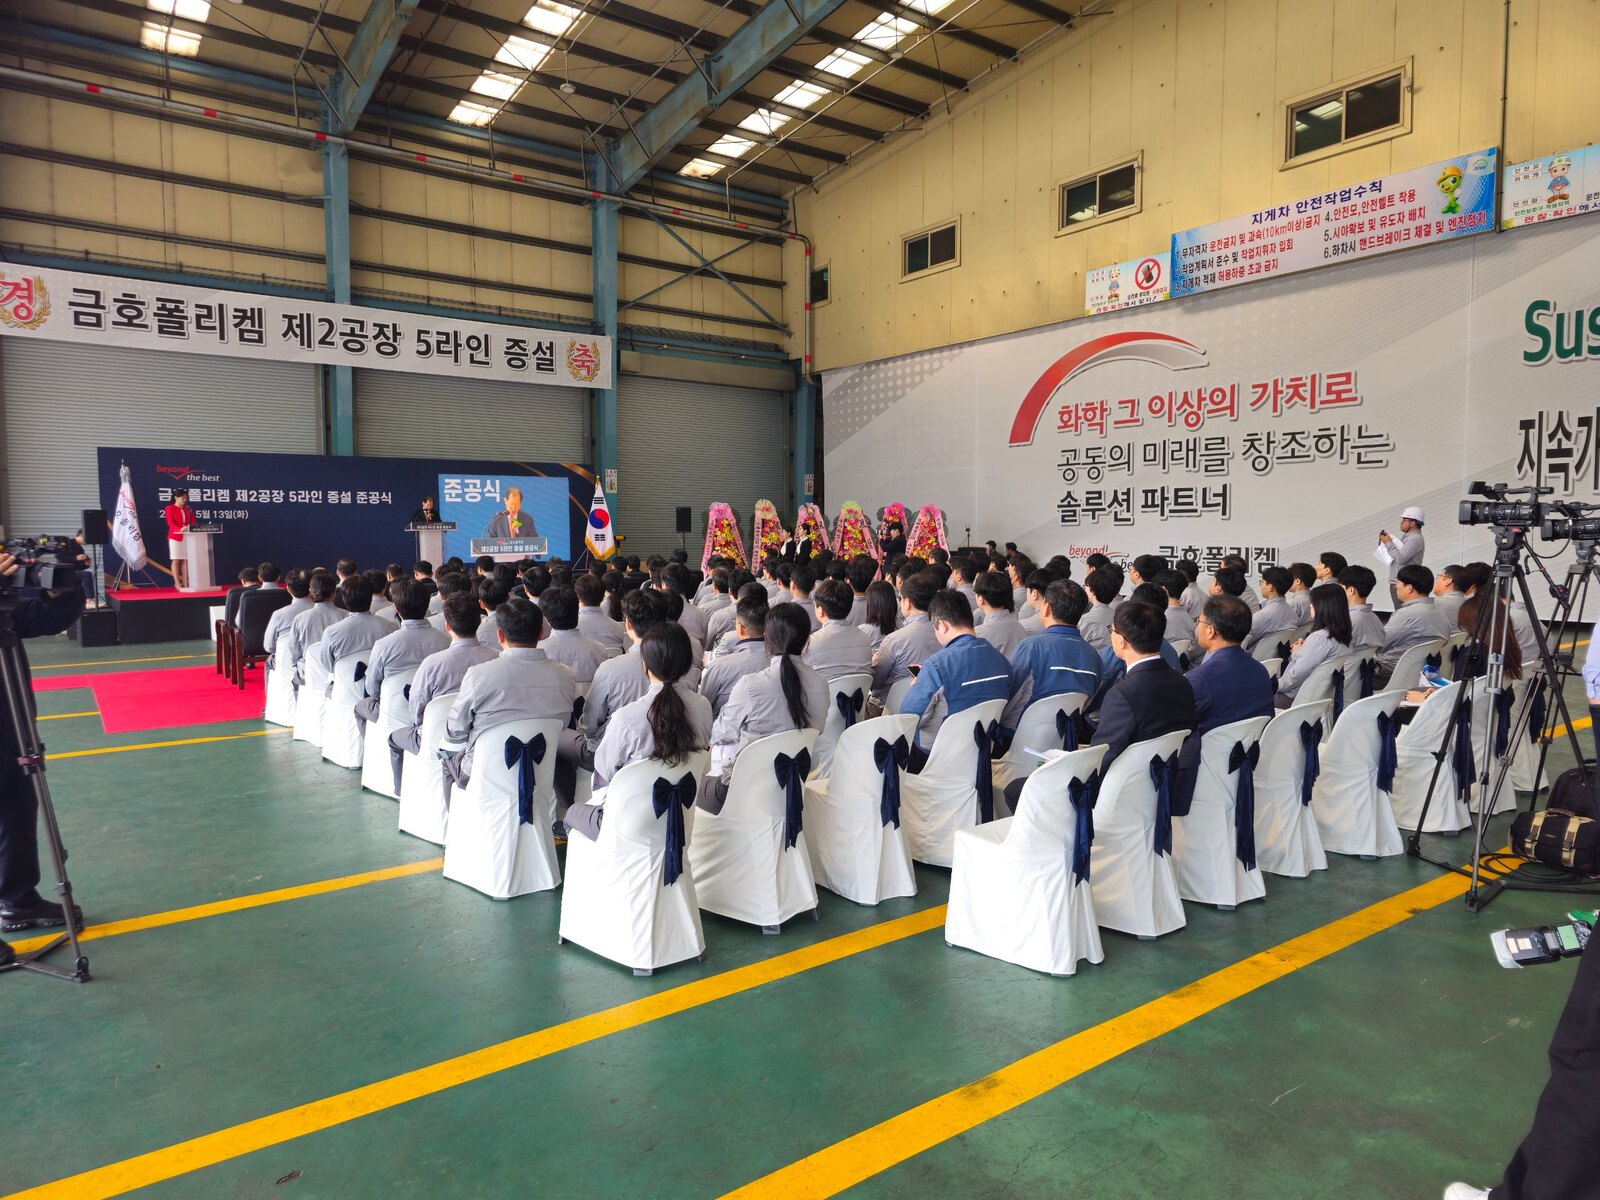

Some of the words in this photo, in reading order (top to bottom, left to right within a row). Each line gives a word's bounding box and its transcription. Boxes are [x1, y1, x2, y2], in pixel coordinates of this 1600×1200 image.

[1251, 204, 1291, 226] 지게차
[1295, 179, 1383, 214] 안전작업수칙
[1398, 188, 1417, 207] 착용
[1358, 227, 1411, 251] 핸드브레이크
[1413, 222, 1432, 239] 체결
[1435, 222, 1445, 236] 및
[1447, 210, 1487, 232] 엔진정지
[1368, 218, 1377, 232] 및
[1379, 212, 1406, 229] 유도자
[1408, 205, 1426, 222] 배치
[1209, 235, 1237, 253] 운전금지
[1238, 233, 1246, 245] 및
[1216, 254, 1230, 268] 준수
[1231, 252, 1239, 264] 및
[1240, 243, 1277, 261] 작업지휘자
[1278, 237, 1294, 253] 입회
[1202, 271, 1216, 285] 적재
[1217, 265, 1246, 282] 허용하중
[1247, 261, 1262, 276] 초과
[1264, 257, 1279, 272] 금지
[67, 287, 265, 345] 금호폴리켐
[280, 311, 402, 357] 제2공장
[415, 328, 491, 367] 5라인
[503, 337, 556, 374] 증설
[569, 342, 597, 377] 축
[1057, 400, 1109, 435] 화학
[1113, 398, 1141, 425] 그
[1147, 383, 1236, 429] 이상의
[1249, 371, 1359, 414] 가치로
[1056, 442, 1132, 482] 공동의
[1143, 436, 1231, 473] 미래를
[1241, 424, 1391, 472] 창조하는
[156, 464, 190, 474] beyond
[186, 473, 201, 482] the
[202, 474, 220, 482] best
[158, 487, 230, 502] 금폴리켐
[235, 489, 285, 503] 제2공장
[289, 490, 323, 504] 5라인
[327, 490, 352, 504] 증설
[356, 491, 392, 505] 준공식
[443, 478, 501, 503] 준공식
[1056, 486, 1132, 523] 솔루션
[1140, 483, 1228, 517] 파트너
[213, 509, 249, 520] 13일(화)
